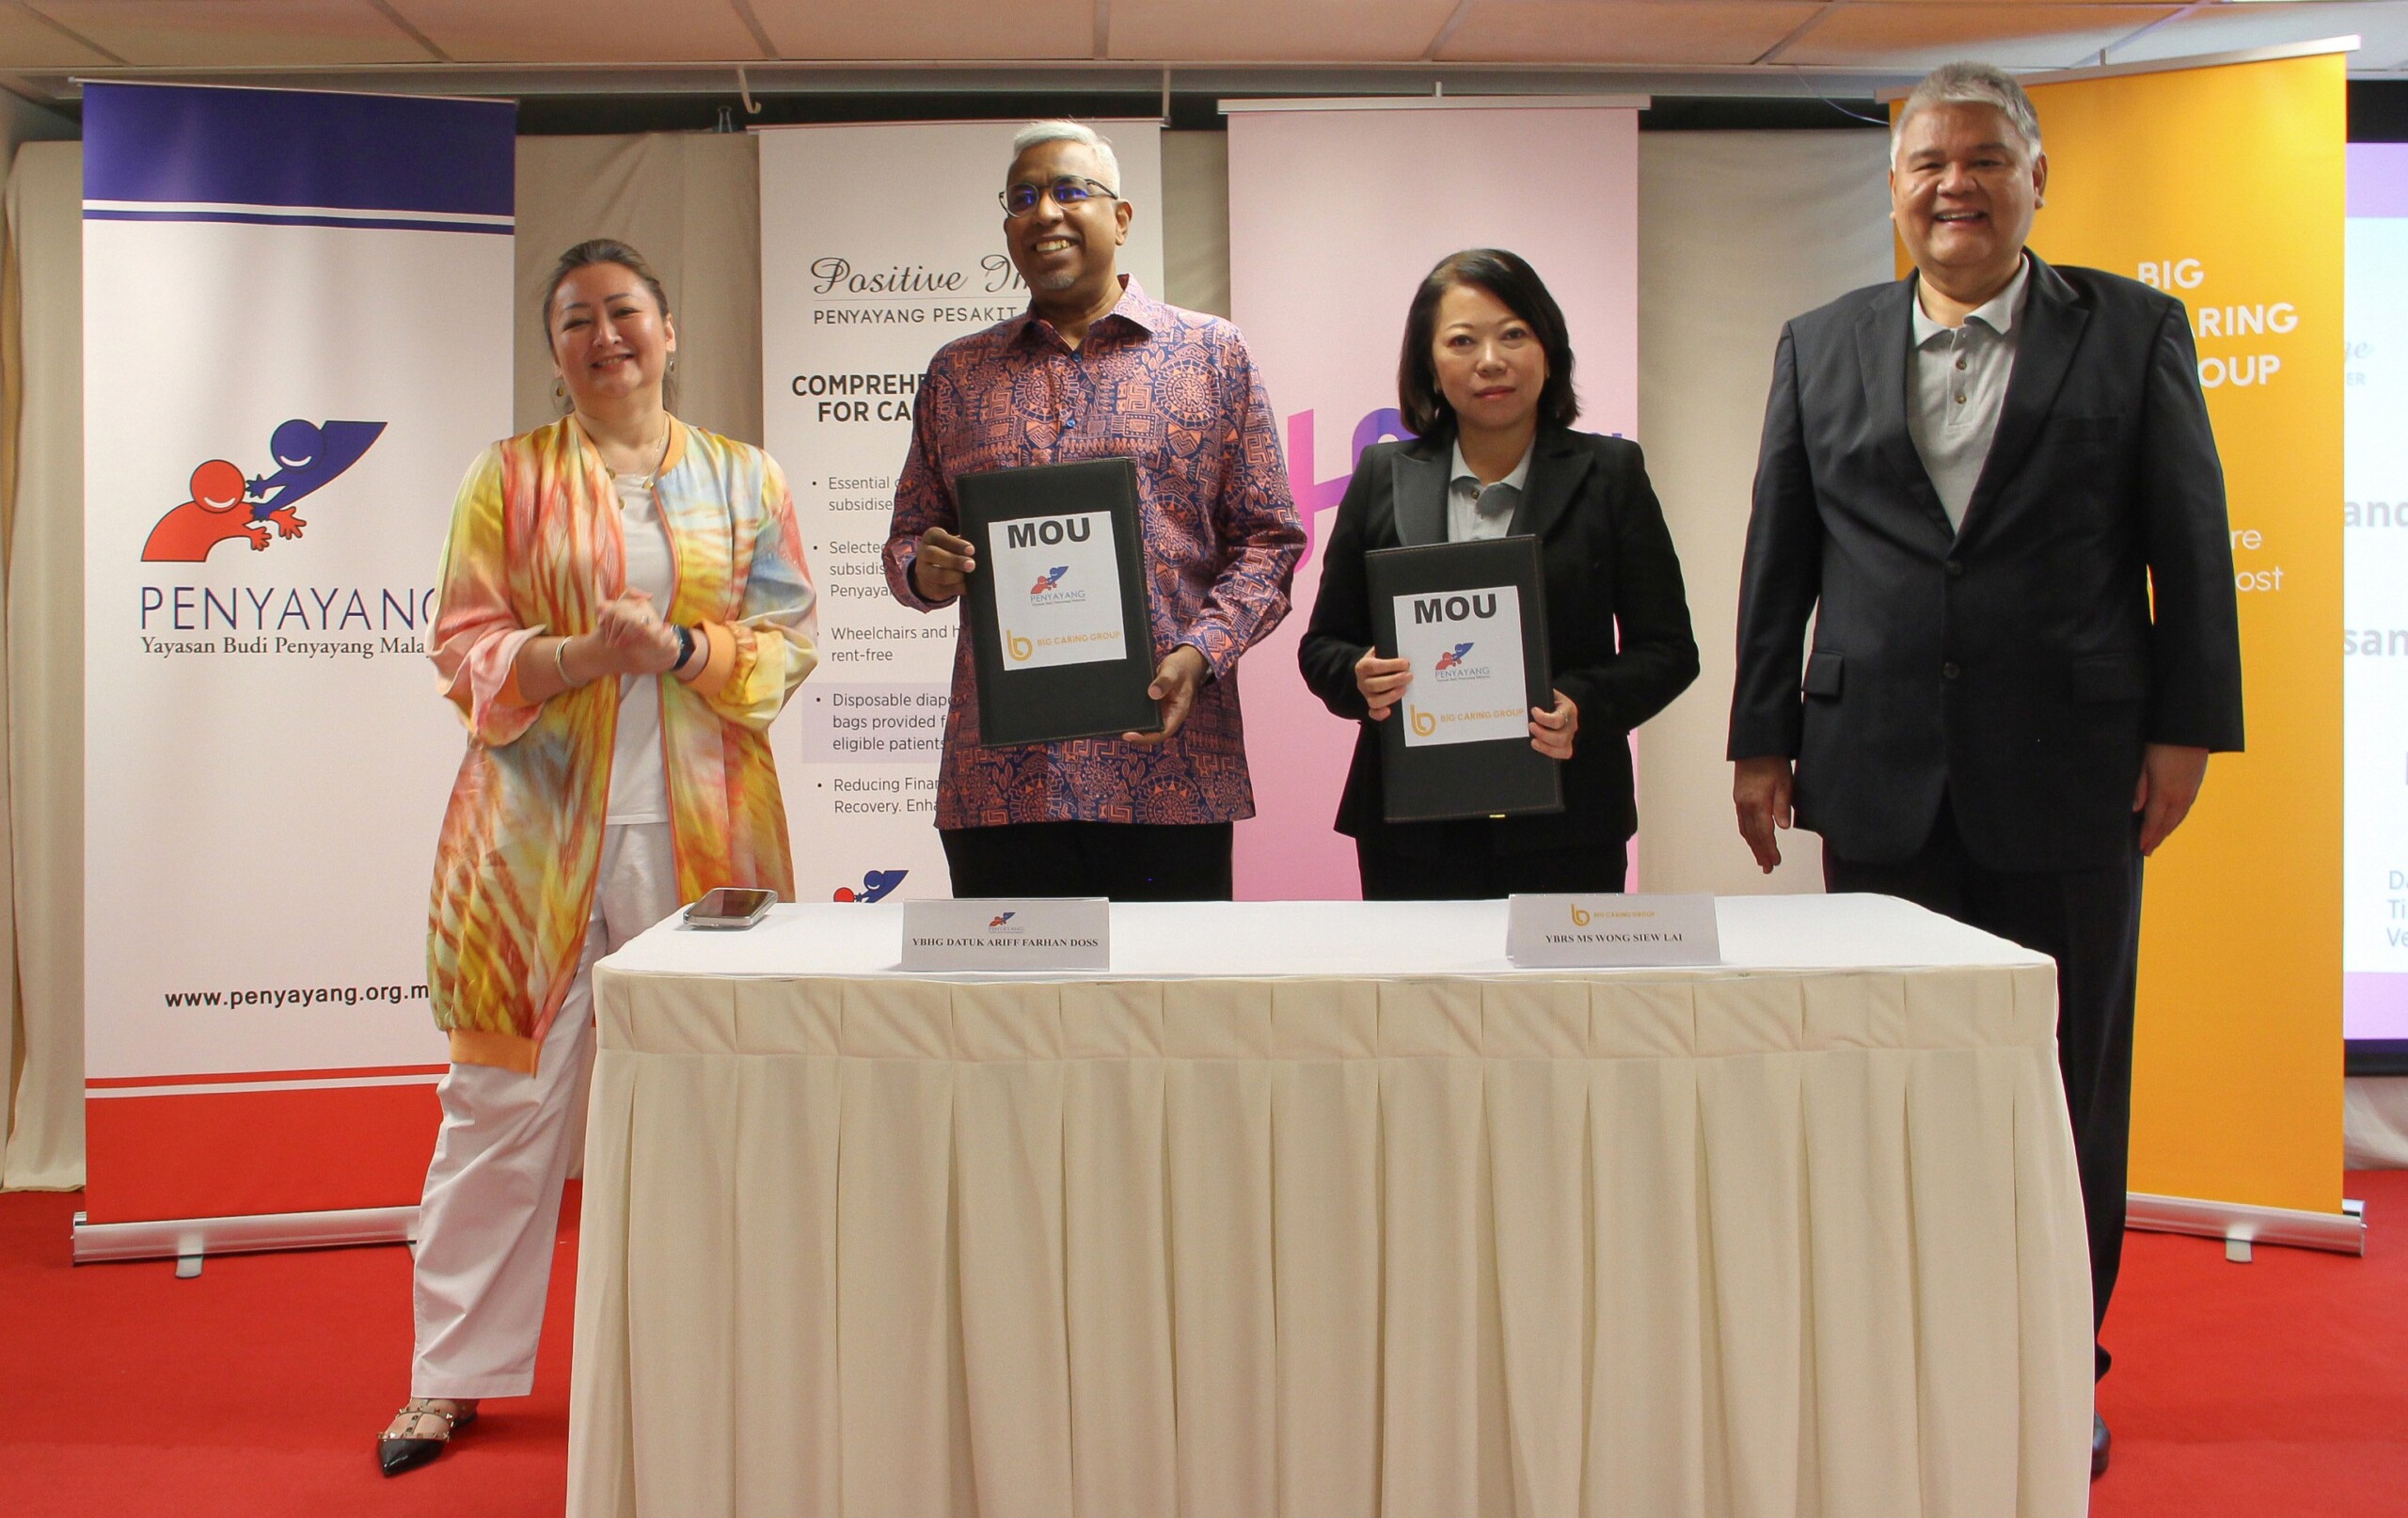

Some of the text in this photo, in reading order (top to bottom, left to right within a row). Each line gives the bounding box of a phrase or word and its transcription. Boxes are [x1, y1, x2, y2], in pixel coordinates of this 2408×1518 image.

[811, 257, 968, 294] Positive
[2138, 258, 2205, 290] BIG
[815, 307, 1017, 324] PENYAYANG PESAKIT
[2191, 302, 2299, 339] RING
[818, 401, 911, 423] FOR CA
[829, 476, 890, 490] Essential
[829, 498, 894, 511] subsidise
[1007, 517, 1091, 548] MOU
[2235, 566, 2284, 593] ost
[831, 584, 892, 599] Penyaya
[1030, 590, 1085, 602] PENYAYANG
[1414, 593, 1497, 624] MOU
[832, 626, 917, 640] Wheelchairs
[922, 625, 947, 639] and
[1038, 639, 1052, 647] BIG
[1054, 634, 1088, 645] CARING
[1090, 631, 1121, 641] GROUP
[141, 636, 430, 660] Yayasan Budi Penyayang Mala
[832, 648, 893, 662] rent-free
[1435, 667, 1490, 678] PENYAYANG
[833, 693, 911, 708] Disposable
[1441, 713, 1455, 722] BIG
[1457, 710, 1491, 721] CARING
[1493, 707, 1524, 718] GROUP
[833, 715, 867, 731] bags
[872, 715, 936, 730] provided
[833, 737, 884, 752] eligible
[833, 778, 900, 793] Reducing
[834, 799, 902, 814] Recovery.
[912, 938, 1099, 948] YBHG DATUK ARIFF FARHAN DOSS
[1545, 935, 1575, 943] YBRS
[1577, 934, 1593, 943] MS
[1595, 934, 1631, 942] WONG
[1663, 933, 1683, 941] LAI
